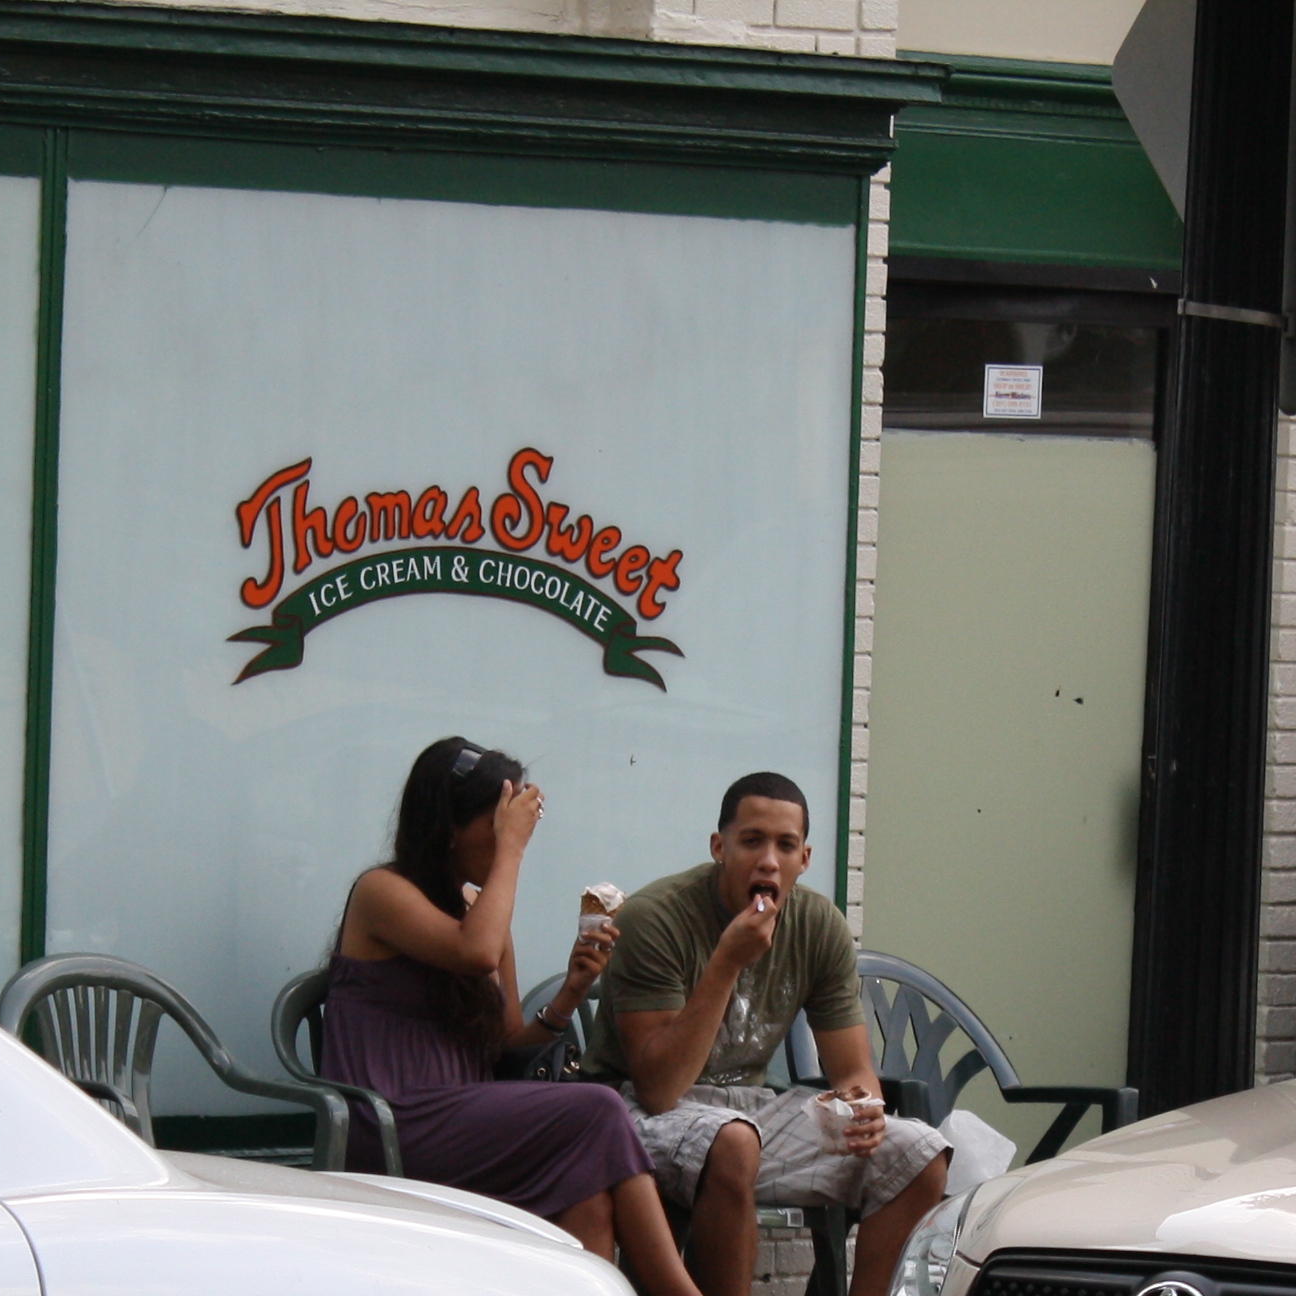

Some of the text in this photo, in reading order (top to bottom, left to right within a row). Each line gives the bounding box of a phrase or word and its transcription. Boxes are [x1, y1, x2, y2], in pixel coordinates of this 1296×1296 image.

[236, 447, 684, 620] Thomas Sweet
[308, 555, 612, 632] ICE CREAM & CHOCOLATE
